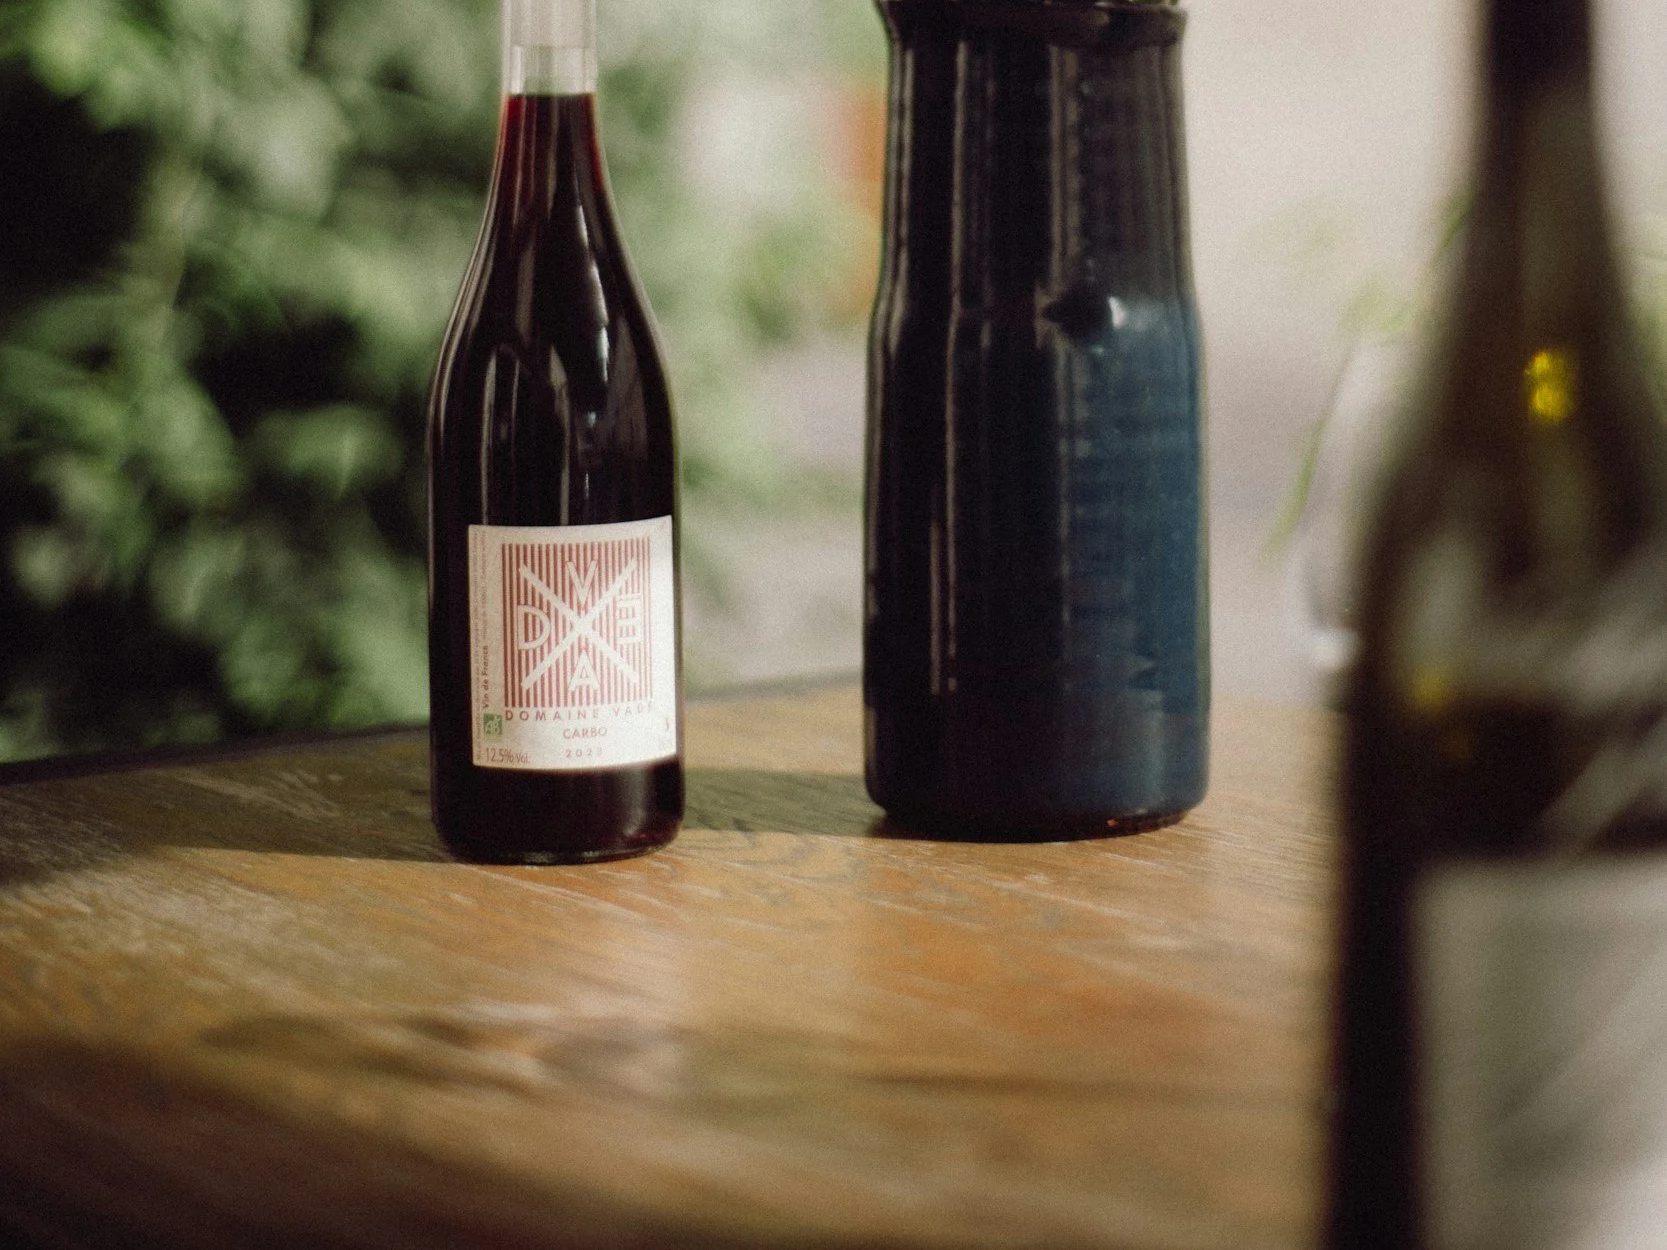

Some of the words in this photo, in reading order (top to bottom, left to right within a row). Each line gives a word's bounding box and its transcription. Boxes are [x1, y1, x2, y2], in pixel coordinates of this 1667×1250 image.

[482, 678, 489, 691] de
[505, 709, 599, 721] DOMAINE
[562, 726, 608, 739] CARBO
